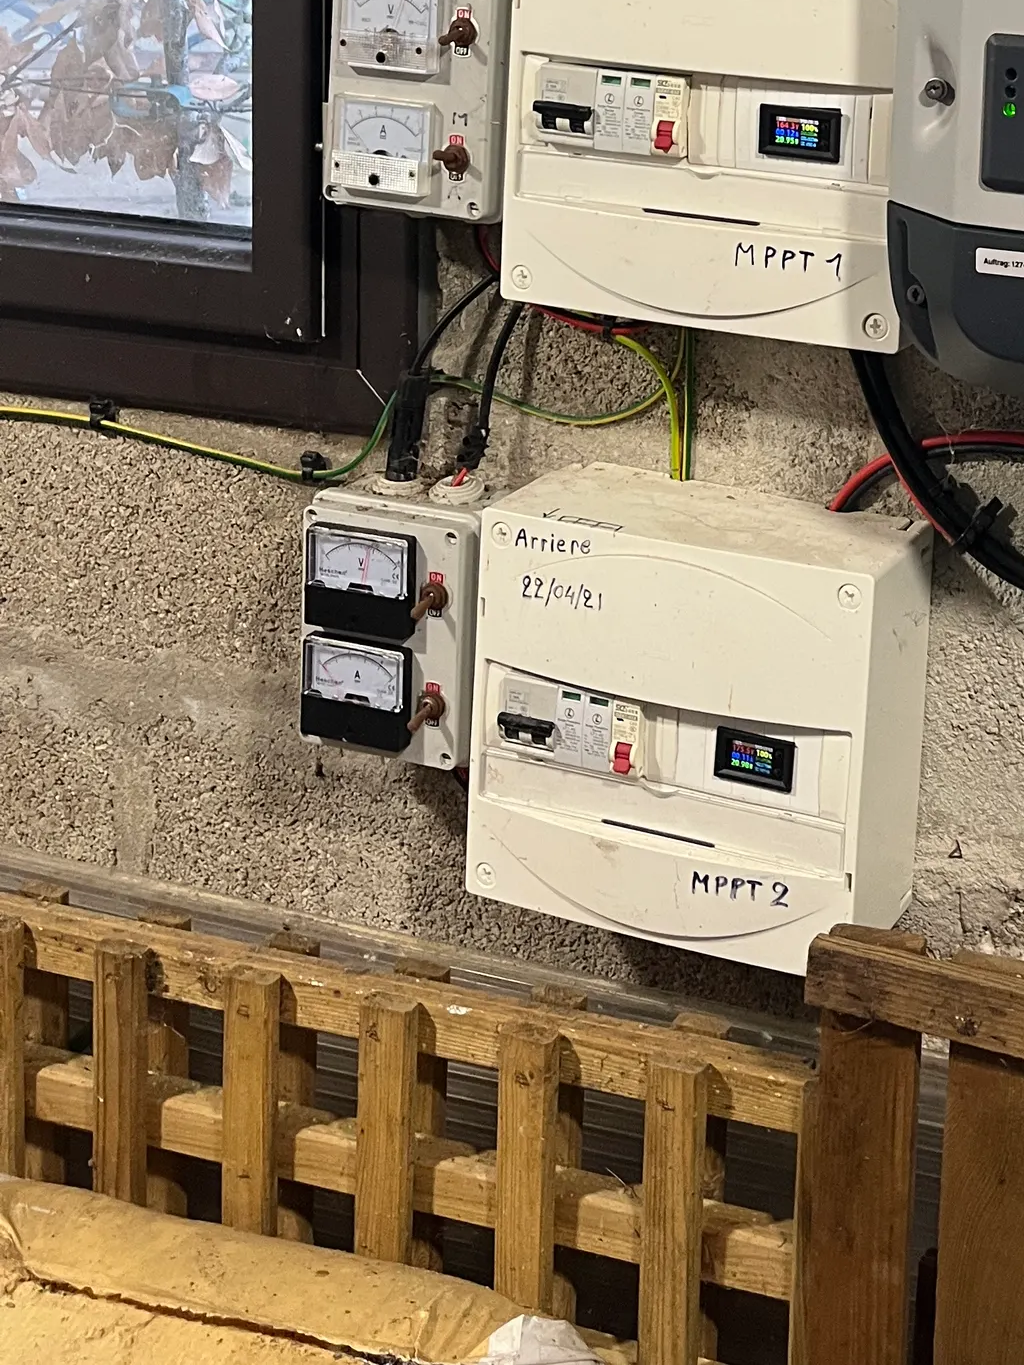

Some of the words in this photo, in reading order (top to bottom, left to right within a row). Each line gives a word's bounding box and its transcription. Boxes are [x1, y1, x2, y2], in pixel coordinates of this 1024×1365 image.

[388, 4, 394, 14] V
[458, 9, 470, 19] ON
[456, 47, 467, 55] OFF
[451, 136, 463, 145] ON
[734, 242, 815, 273] MPPT
[825, 253, 843, 282] 1
[983, 257, 1010, 268] Auftrag:
[431, 573, 442, 583] ON
[521, 575, 603, 610] 22/04/21
[354, 670, 361, 680] A
[427, 684, 439, 692] ON
[691, 872, 763, 902] MPPT
[771, 882, 790, 908] 2
